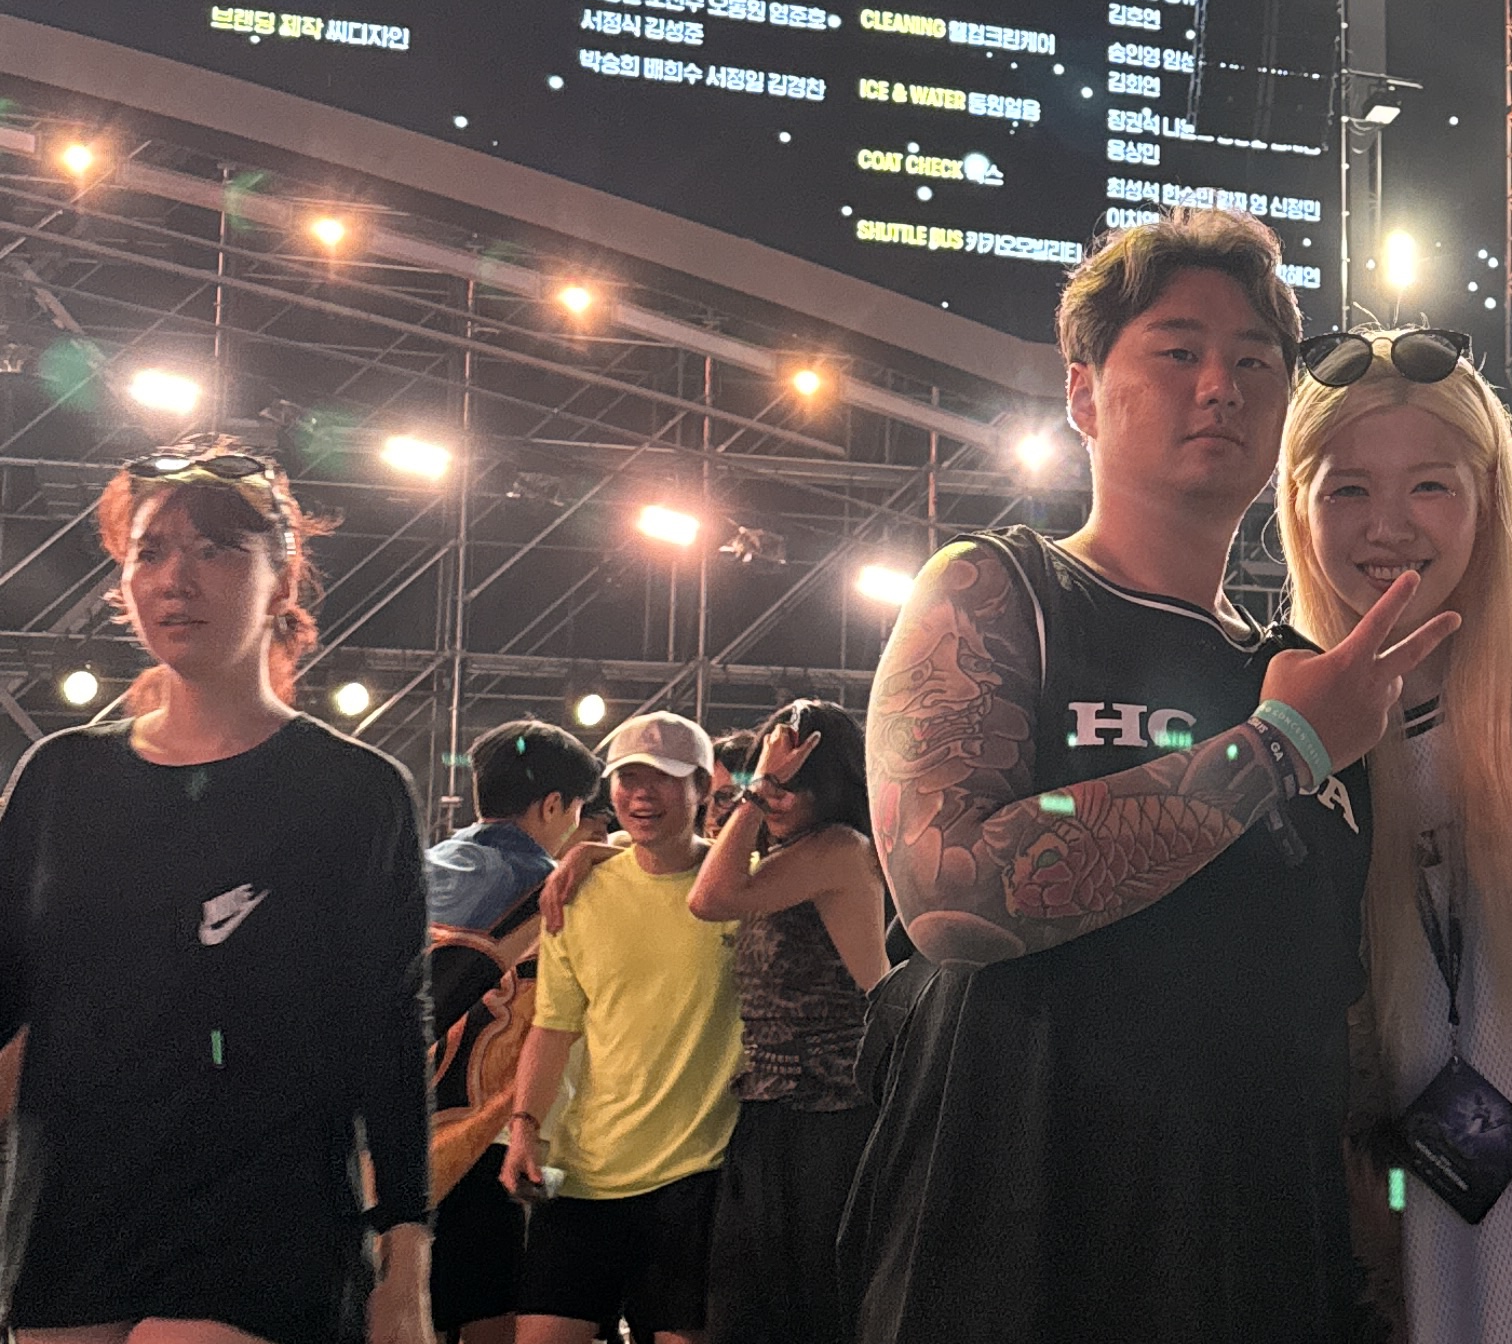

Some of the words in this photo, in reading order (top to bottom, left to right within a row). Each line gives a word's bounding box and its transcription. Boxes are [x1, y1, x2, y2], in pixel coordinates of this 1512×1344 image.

[211, 6, 275, 34] 브랜딩
[861, 9, 946, 39] CLEANING
[860, 79, 889, 101] ICE
[892, 83, 907, 104] &
[909, 85, 965, 111] WATER
[858, 149, 902, 172] COAT
[906, 155, 963, 180] CHECK
[857, 221, 927, 246] SHUTTLE
